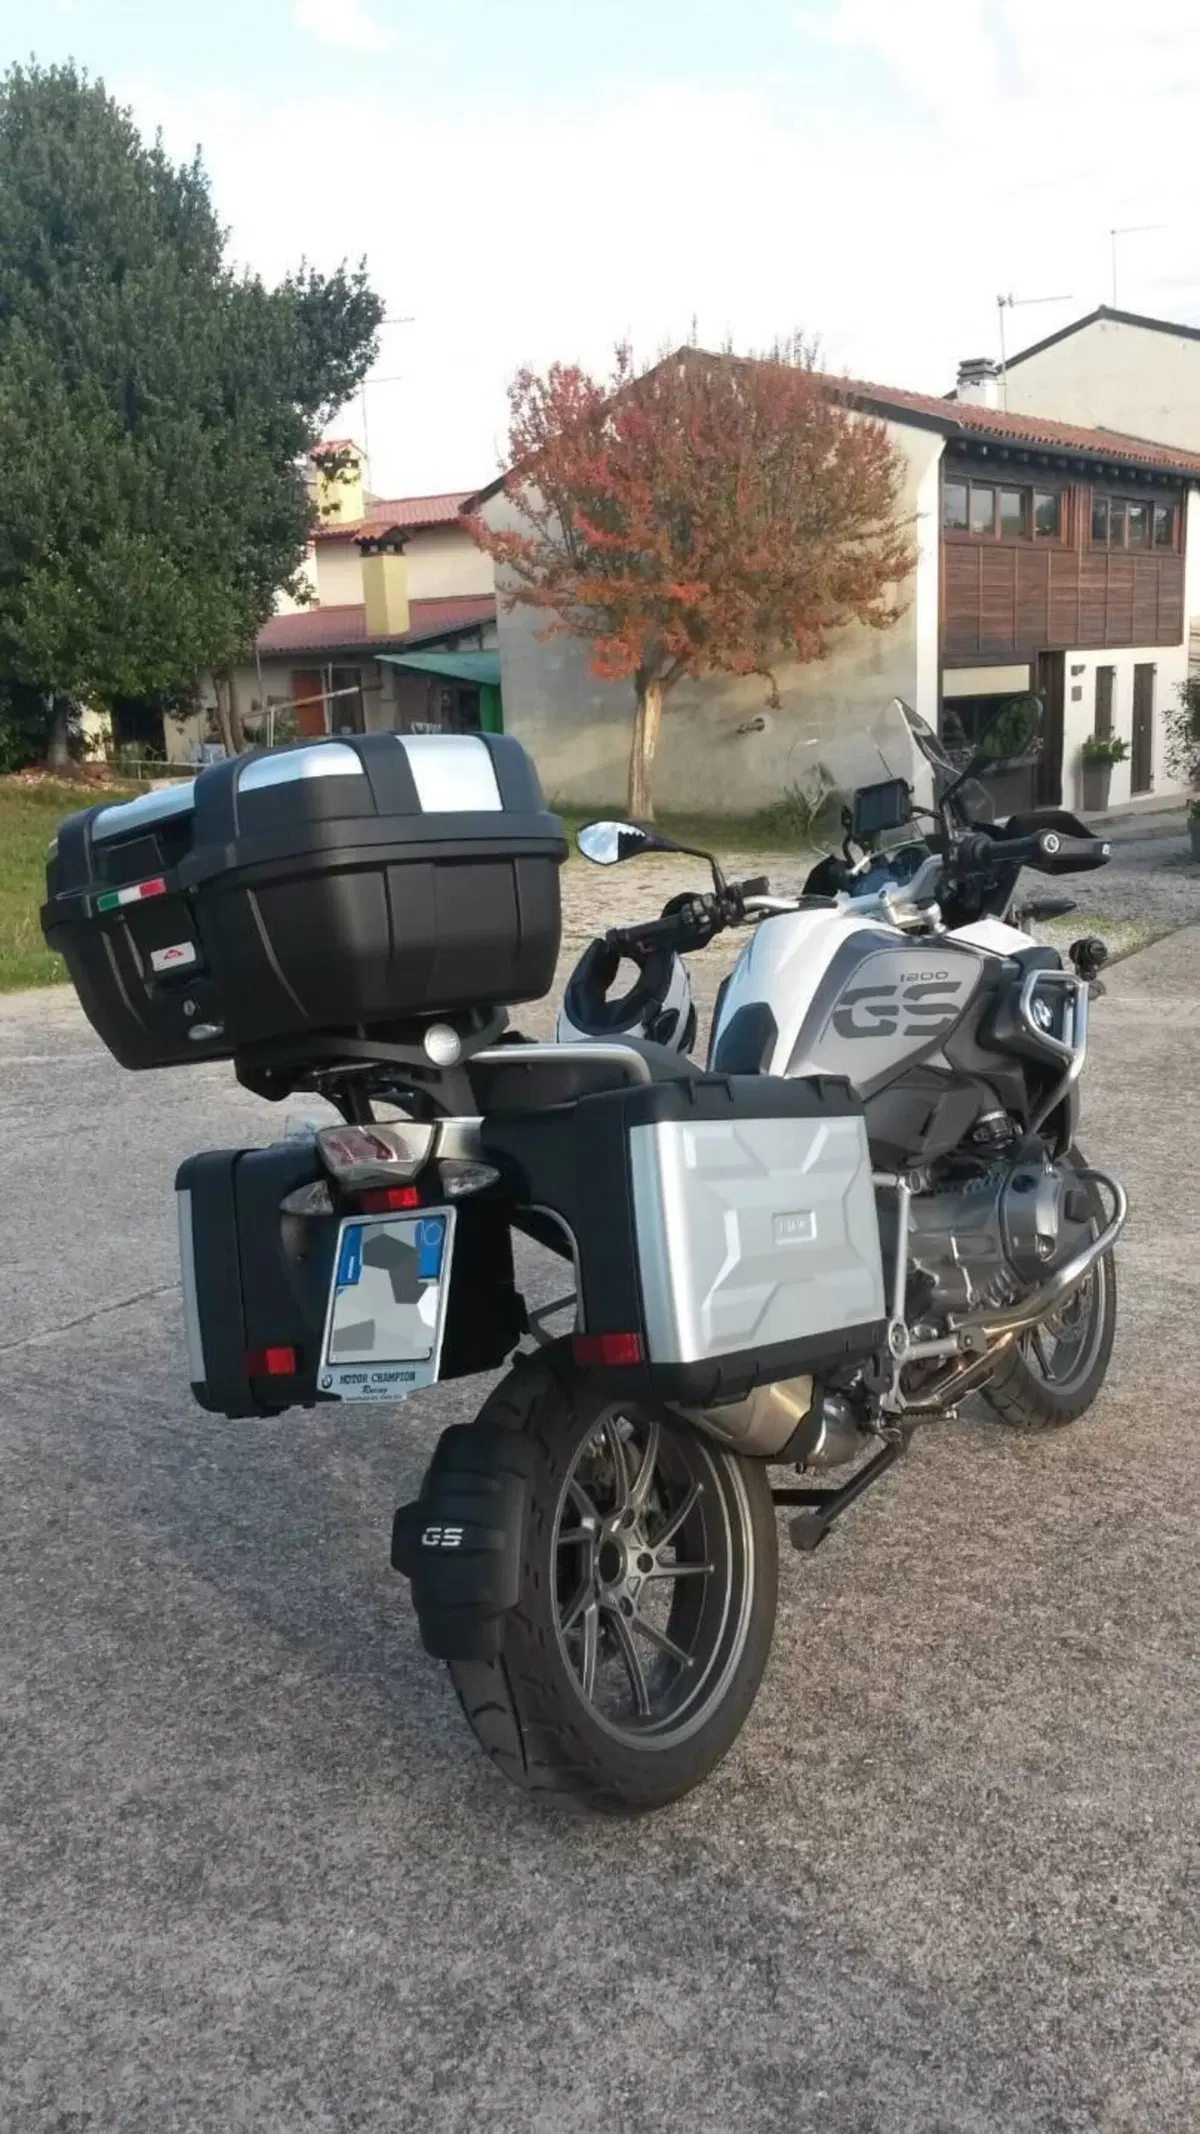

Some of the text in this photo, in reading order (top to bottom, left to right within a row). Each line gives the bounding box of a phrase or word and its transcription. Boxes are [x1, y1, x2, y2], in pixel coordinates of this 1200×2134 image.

[900, 971, 949, 983] 1200
[833, 982, 962, 1038] GS
[339, 1370, 416, 1384] MOTOR CHAMPION
[422, 1528, 463, 1546] GS
